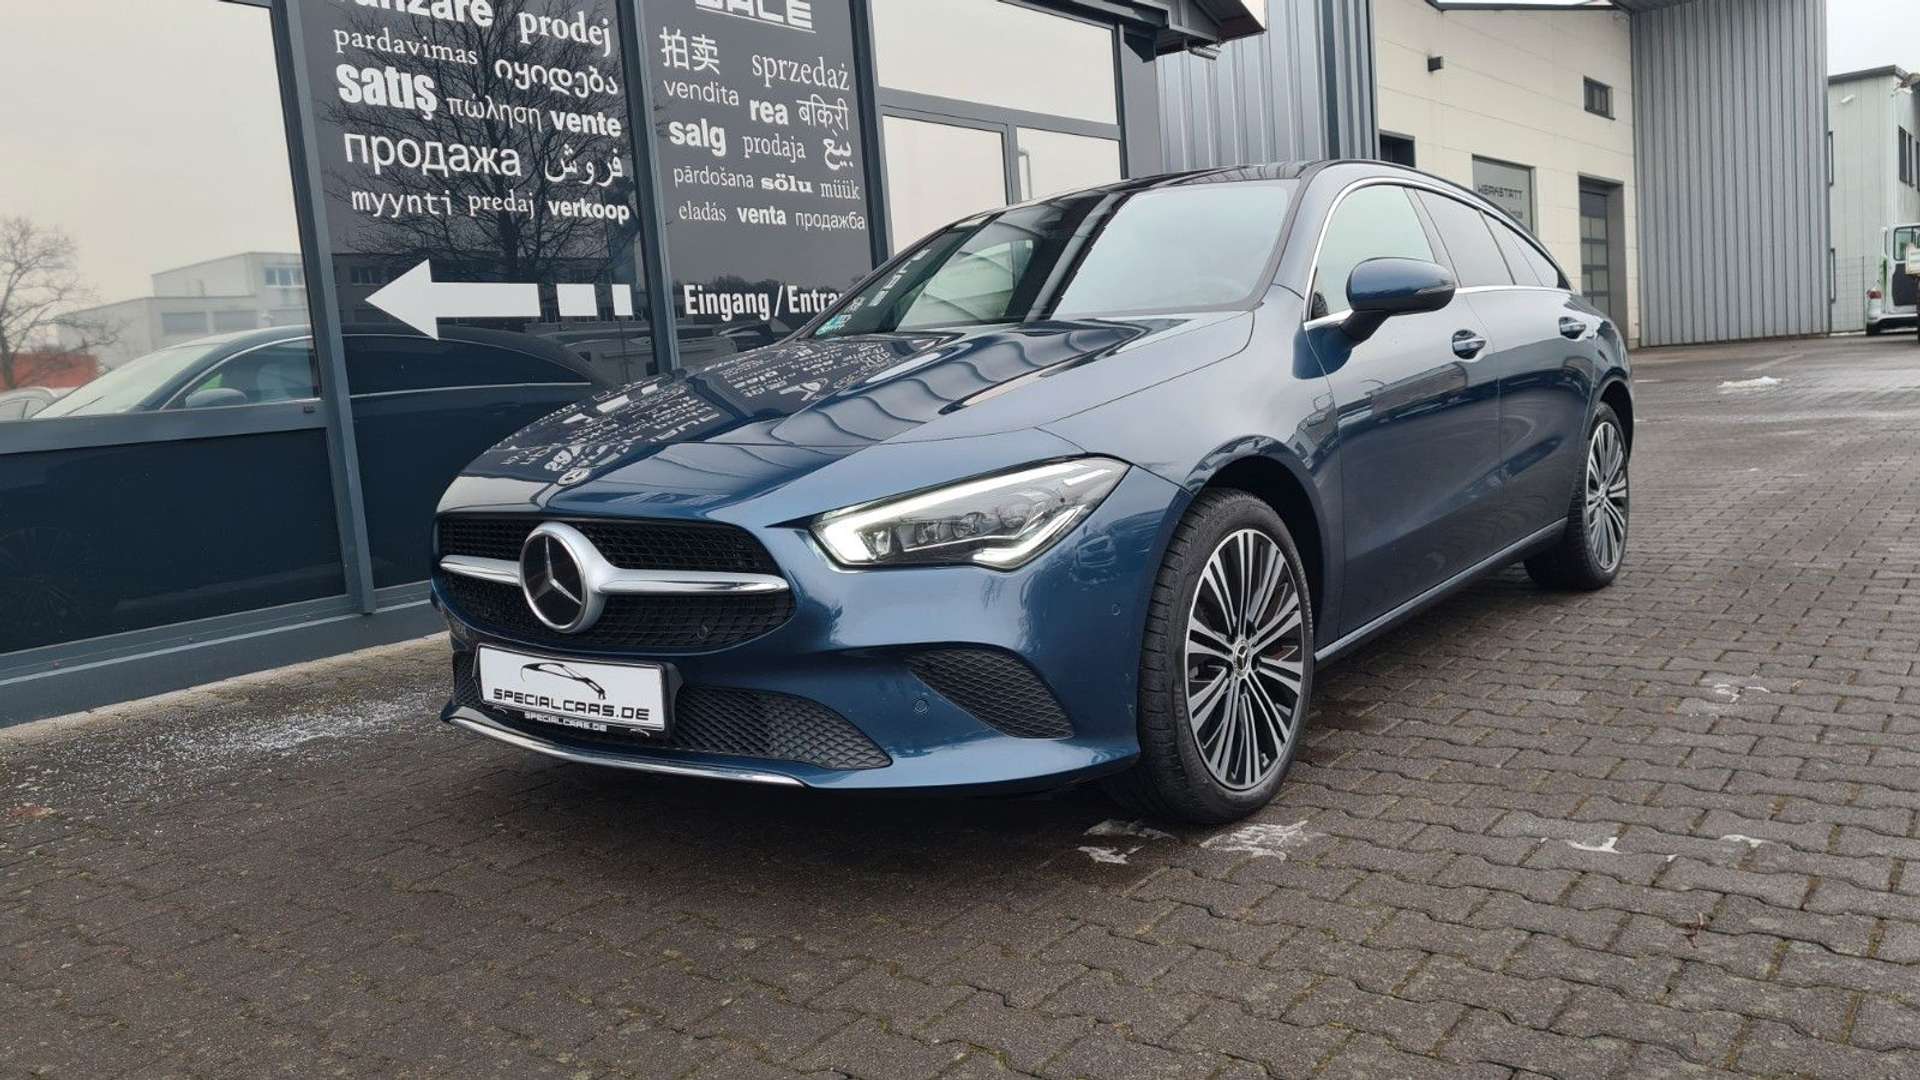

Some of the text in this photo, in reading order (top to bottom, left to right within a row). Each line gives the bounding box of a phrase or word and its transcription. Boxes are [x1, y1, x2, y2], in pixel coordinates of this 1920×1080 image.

[334, 27, 478, 65] pardavimas
[518, 11, 611, 57] prodej
[659, 26, 720, 75] 拍卖
[495, 59, 618, 98] იყიდება
[752, 54, 850, 91] sprzedaż
[336, 64, 438, 121] satış
[663, 80, 739, 106] vendita
[446, 93, 542, 133] πώληση
[549, 110, 622, 138] vente
[750, 99, 789, 125] rea
[344, 133, 522, 178] продажа
[668, 118, 726, 157] salg
[742, 133, 807, 163] prodaja
[674, 165, 861, 200] pārdošana sölu müük
[352, 189, 630, 225] myynti predaj verkoop
[678, 200, 787, 226] eladás venta
[795, 211, 866, 231] продажба
[683, 284, 770, 322] Eingang
[787, 285, 845, 313] Entra
[493, 688, 650, 721] SPECIALCARS.DE
[524, 711, 607, 732] SPECIALCARS.DE
